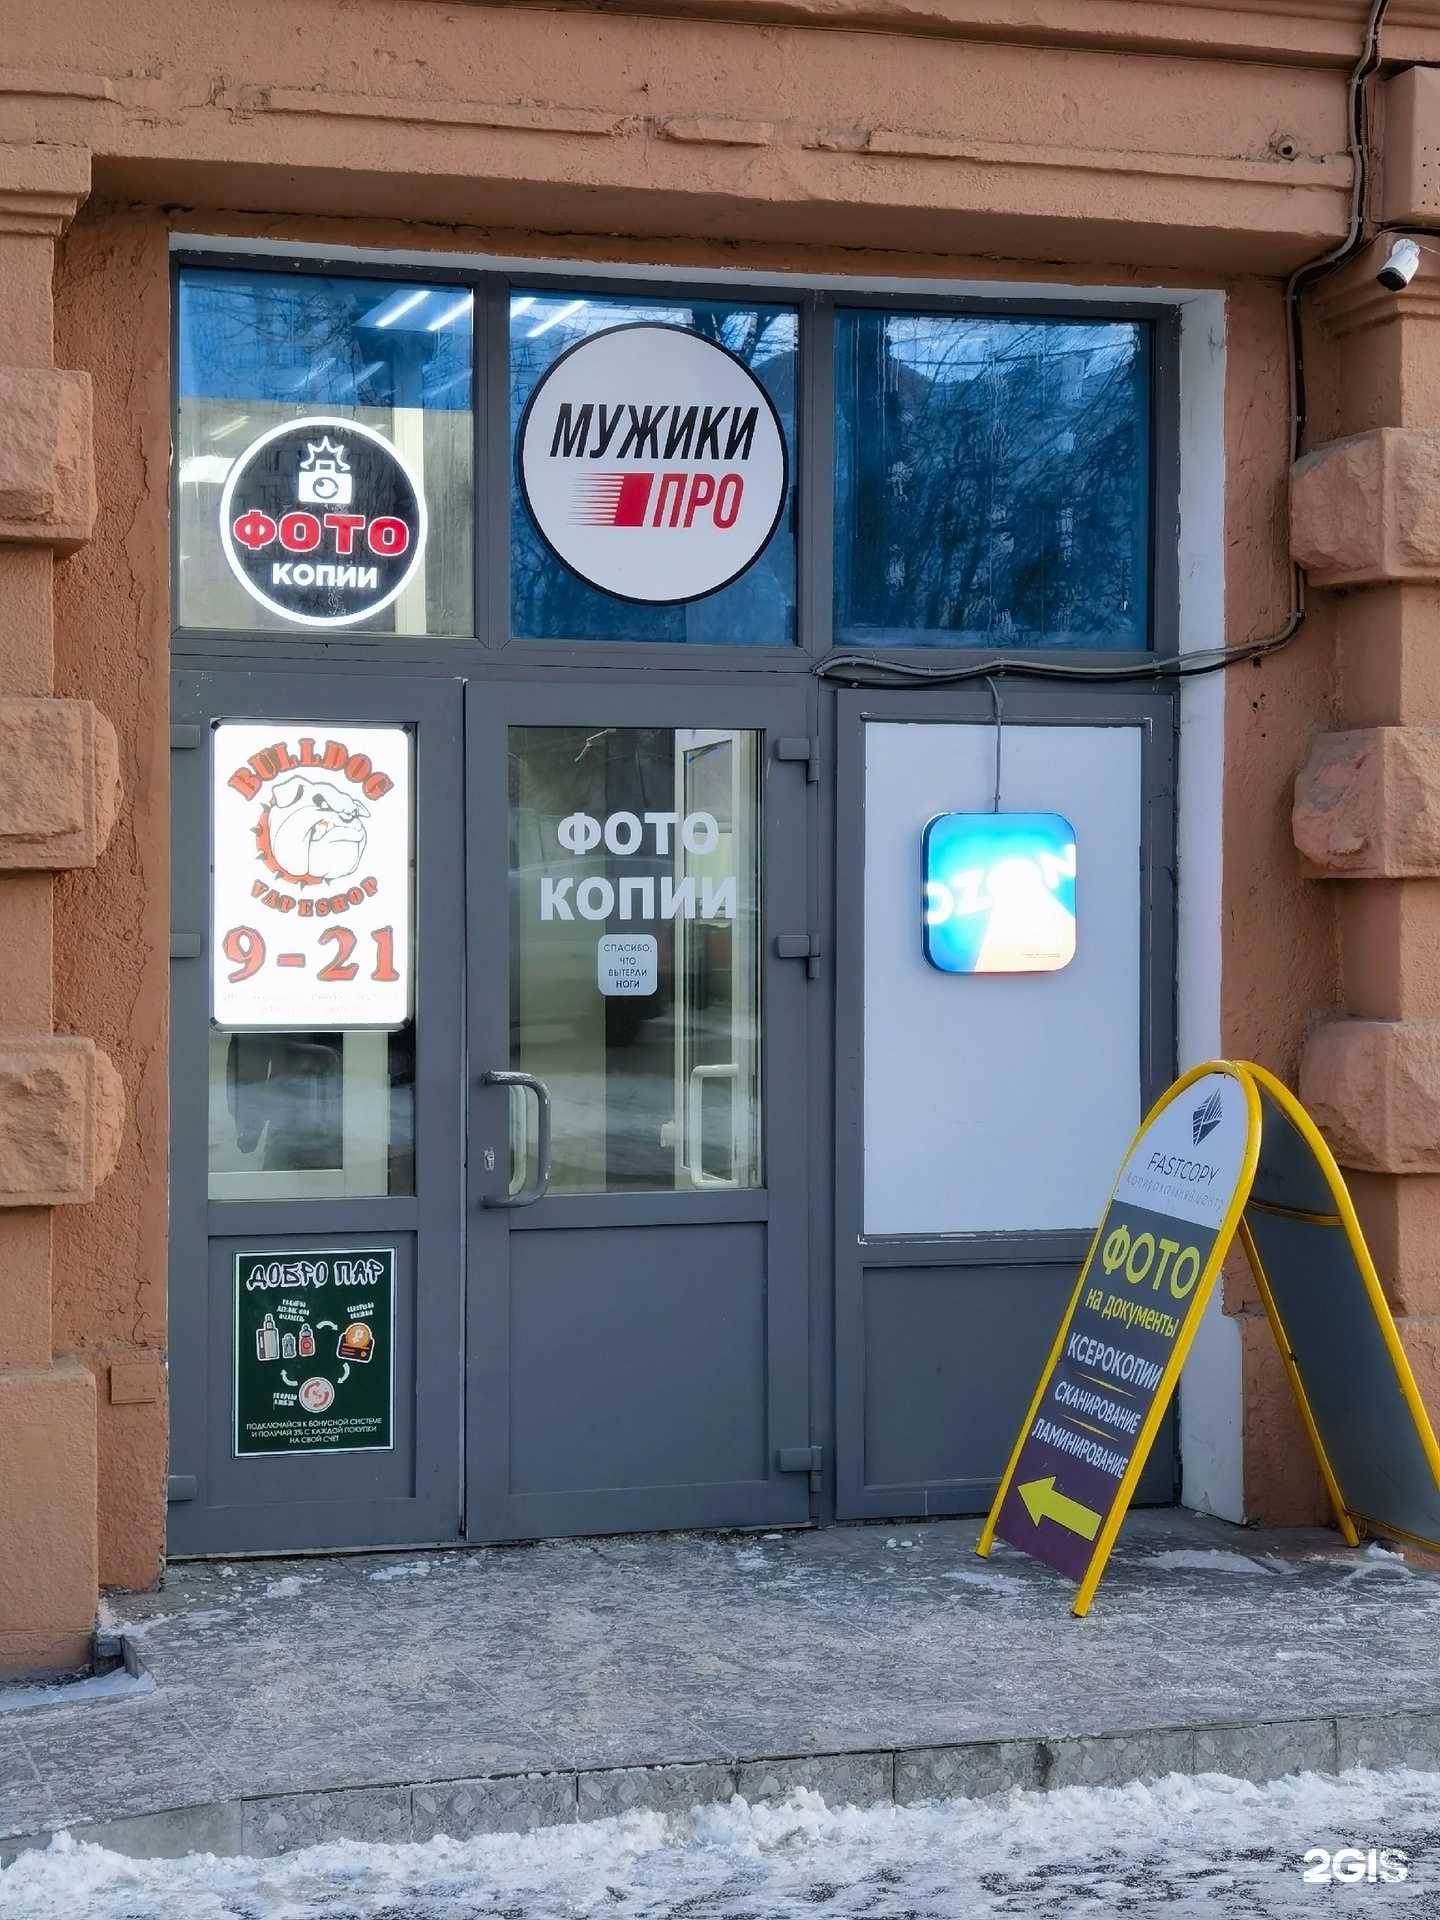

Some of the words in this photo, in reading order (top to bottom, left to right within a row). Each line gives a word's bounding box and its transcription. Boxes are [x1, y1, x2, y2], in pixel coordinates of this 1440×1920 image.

[549, 403, 759, 460] МУЖИКИ
[652, 473, 744, 528] ПРО
[233, 510, 409, 557] ФОТО
[272, 563, 378, 589] КОПИИ
[227, 738, 394, 801] BULLDOG
[558, 811, 719, 855] ФОТО
[541, 877, 737, 920] КОПИИ
[604, 944, 652, 953] СПАСИБО,
[619, 957, 636, 965] ЧТО
[609, 968, 647, 977] ВЫТЕРЛИ
[616, 980, 640, 989] НОГИ
[1147, 1152, 1220, 1186] FASTCOPY
[246, 1261, 329, 1291] ДОБРО
[334, 1259, 385, 1286] ПАР
[1103, 1225, 1200, 1299] ФОТО
[1085, 1288, 1103, 1311] на
[1102, 1295, 1180, 1338] документы
[1068, 1332, 1164, 1391] КСЕРОКОПИИ
[246, 1421, 302, 1431] ПОДКЛЮЧАЙСЯ
[308, 1418, 349, 1428] БОНУСНОЙ
[349, 1417, 383, 1425] СИСТЕМЕ
[1055, 1381, 1142, 1434] СКАНИРОВАНИЕ
[258, 1430, 292, 1438] ПОЛУЧАЙ
[312, 1426, 343, 1436] КАЖДОЙ
[343, 1425, 377, 1434] ПОКУПКИ
[301, 1435, 323, 1443] СВОЙ
[1032, 1418, 1129, 1479] ЛАМИНИРОВАНИЕ
